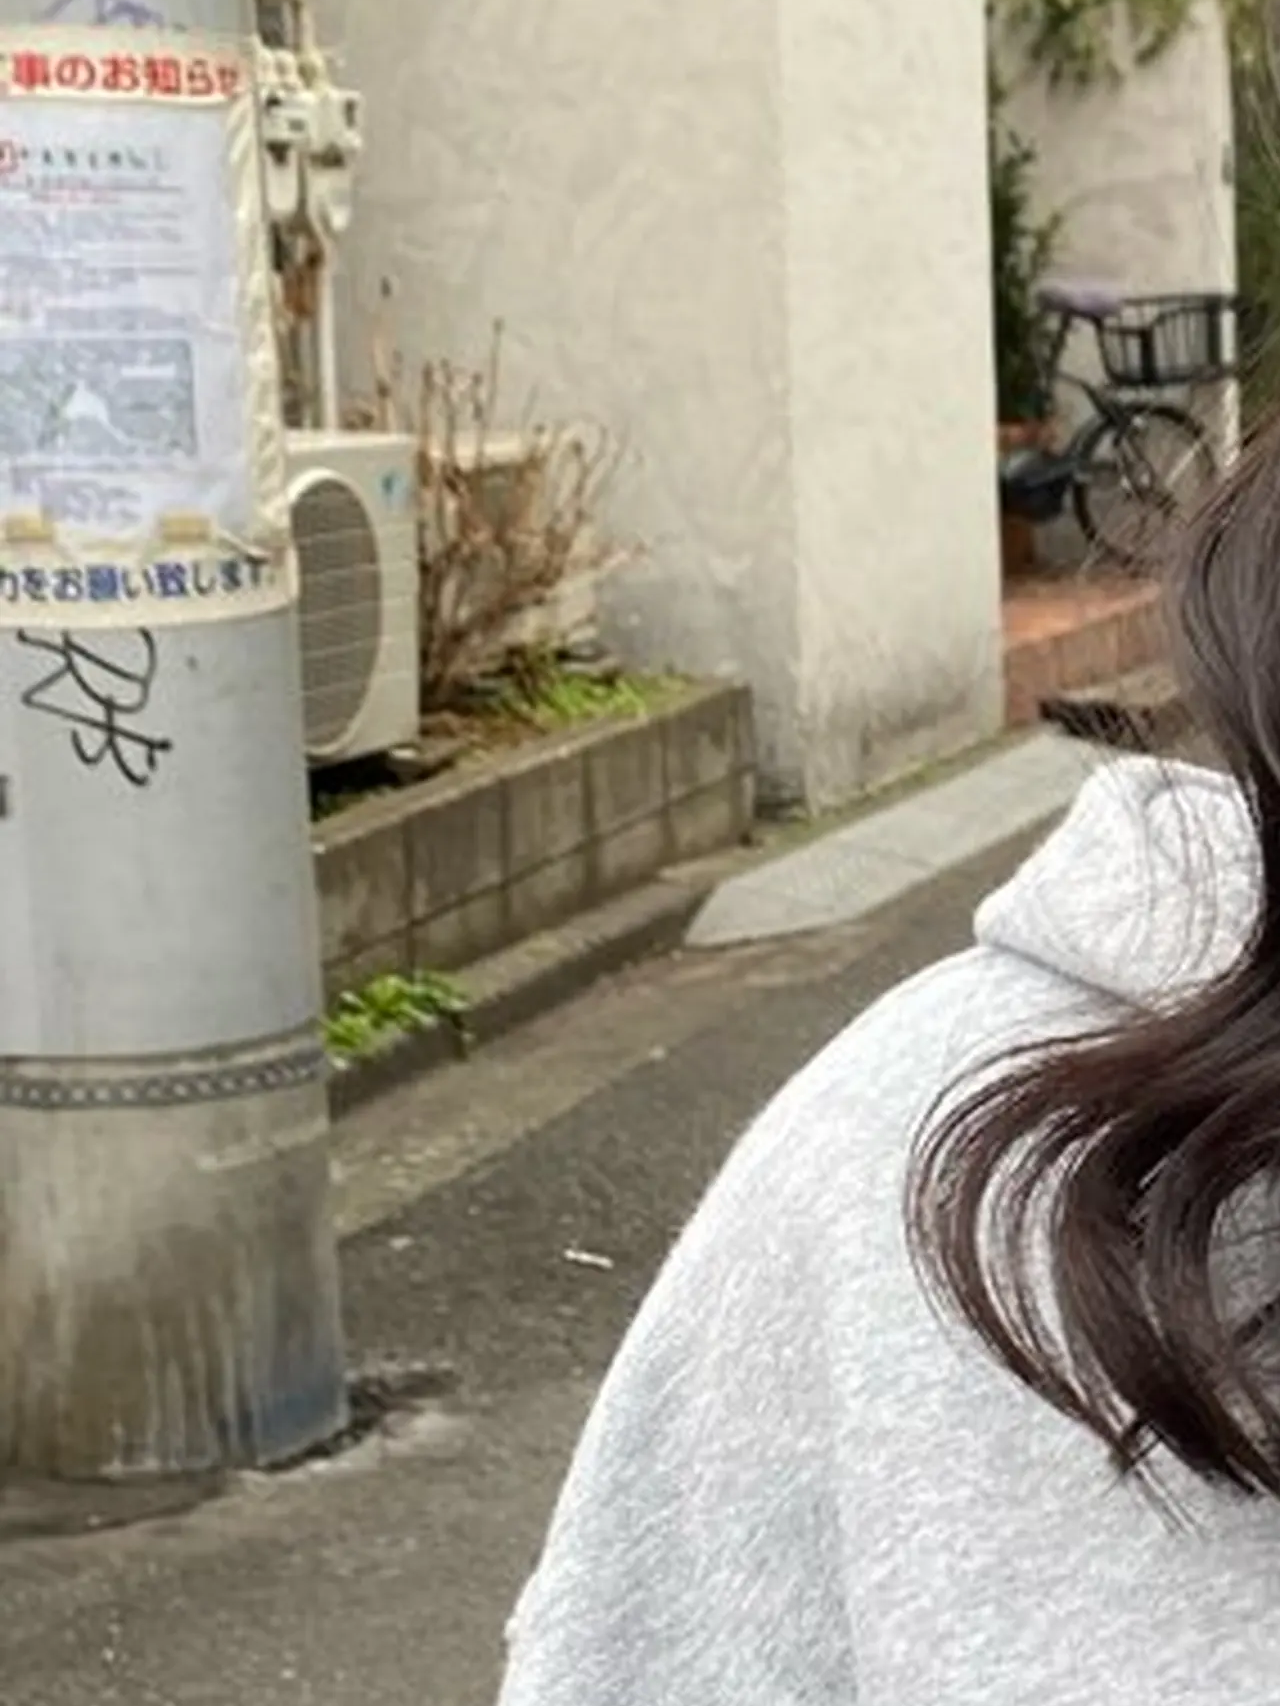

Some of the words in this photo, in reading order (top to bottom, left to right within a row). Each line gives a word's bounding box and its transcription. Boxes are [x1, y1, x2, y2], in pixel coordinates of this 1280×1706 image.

[0, 50, 240, 97] 事のお知らせ
